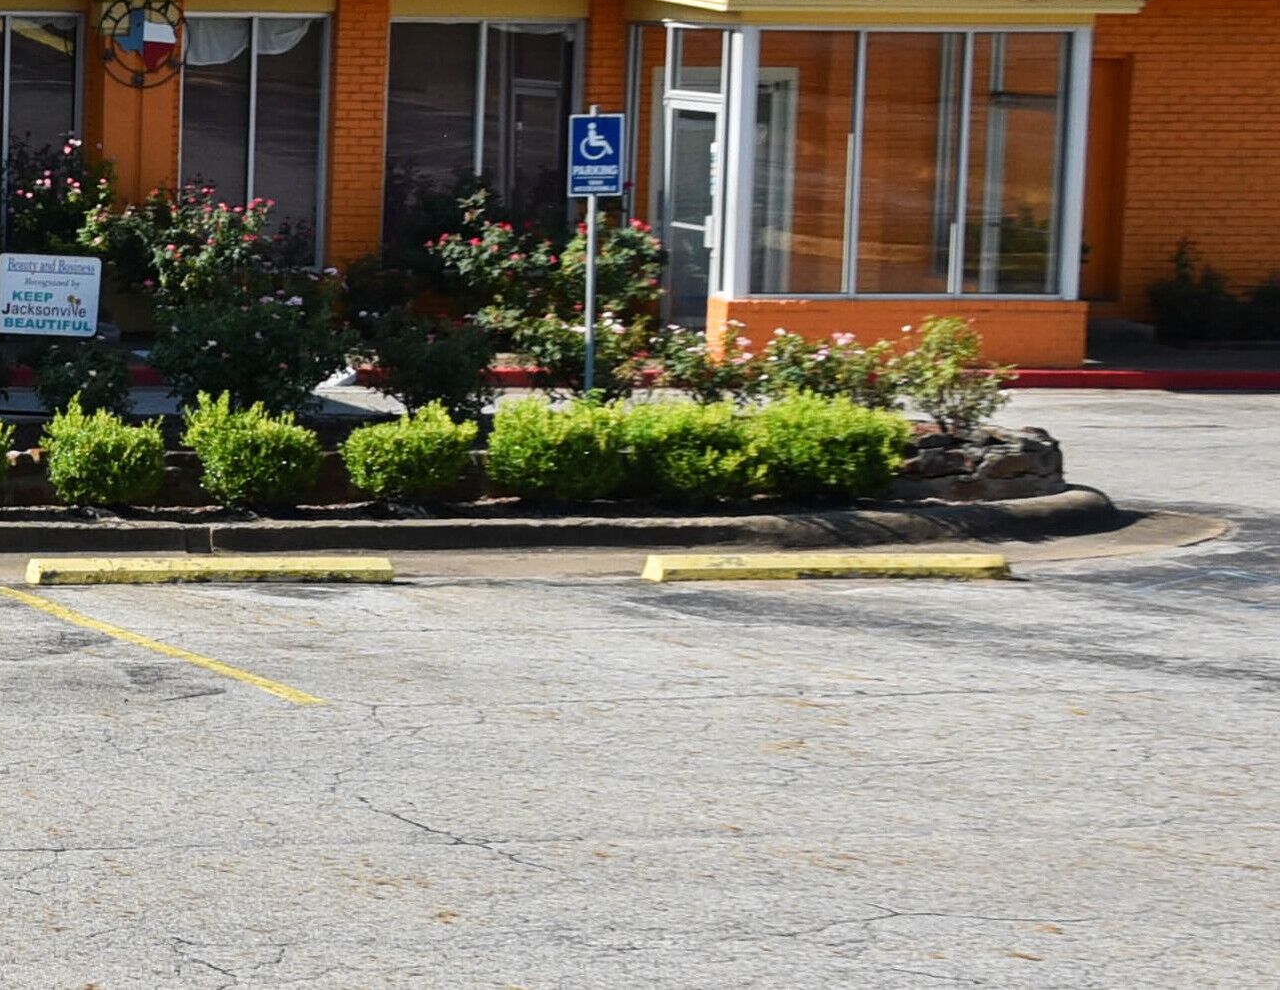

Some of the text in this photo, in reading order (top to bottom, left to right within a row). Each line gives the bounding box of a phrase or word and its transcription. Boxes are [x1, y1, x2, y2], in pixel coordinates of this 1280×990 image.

[572, 165, 618, 176] PARKING
[7, 257, 37, 274] Beauty
[40, 259, 56, 273] and
[12, 290, 54, 302] KEEP
[1, 302, 87, 318] Jacksonville
[4, 317, 92, 331] BEAUTIFUL
